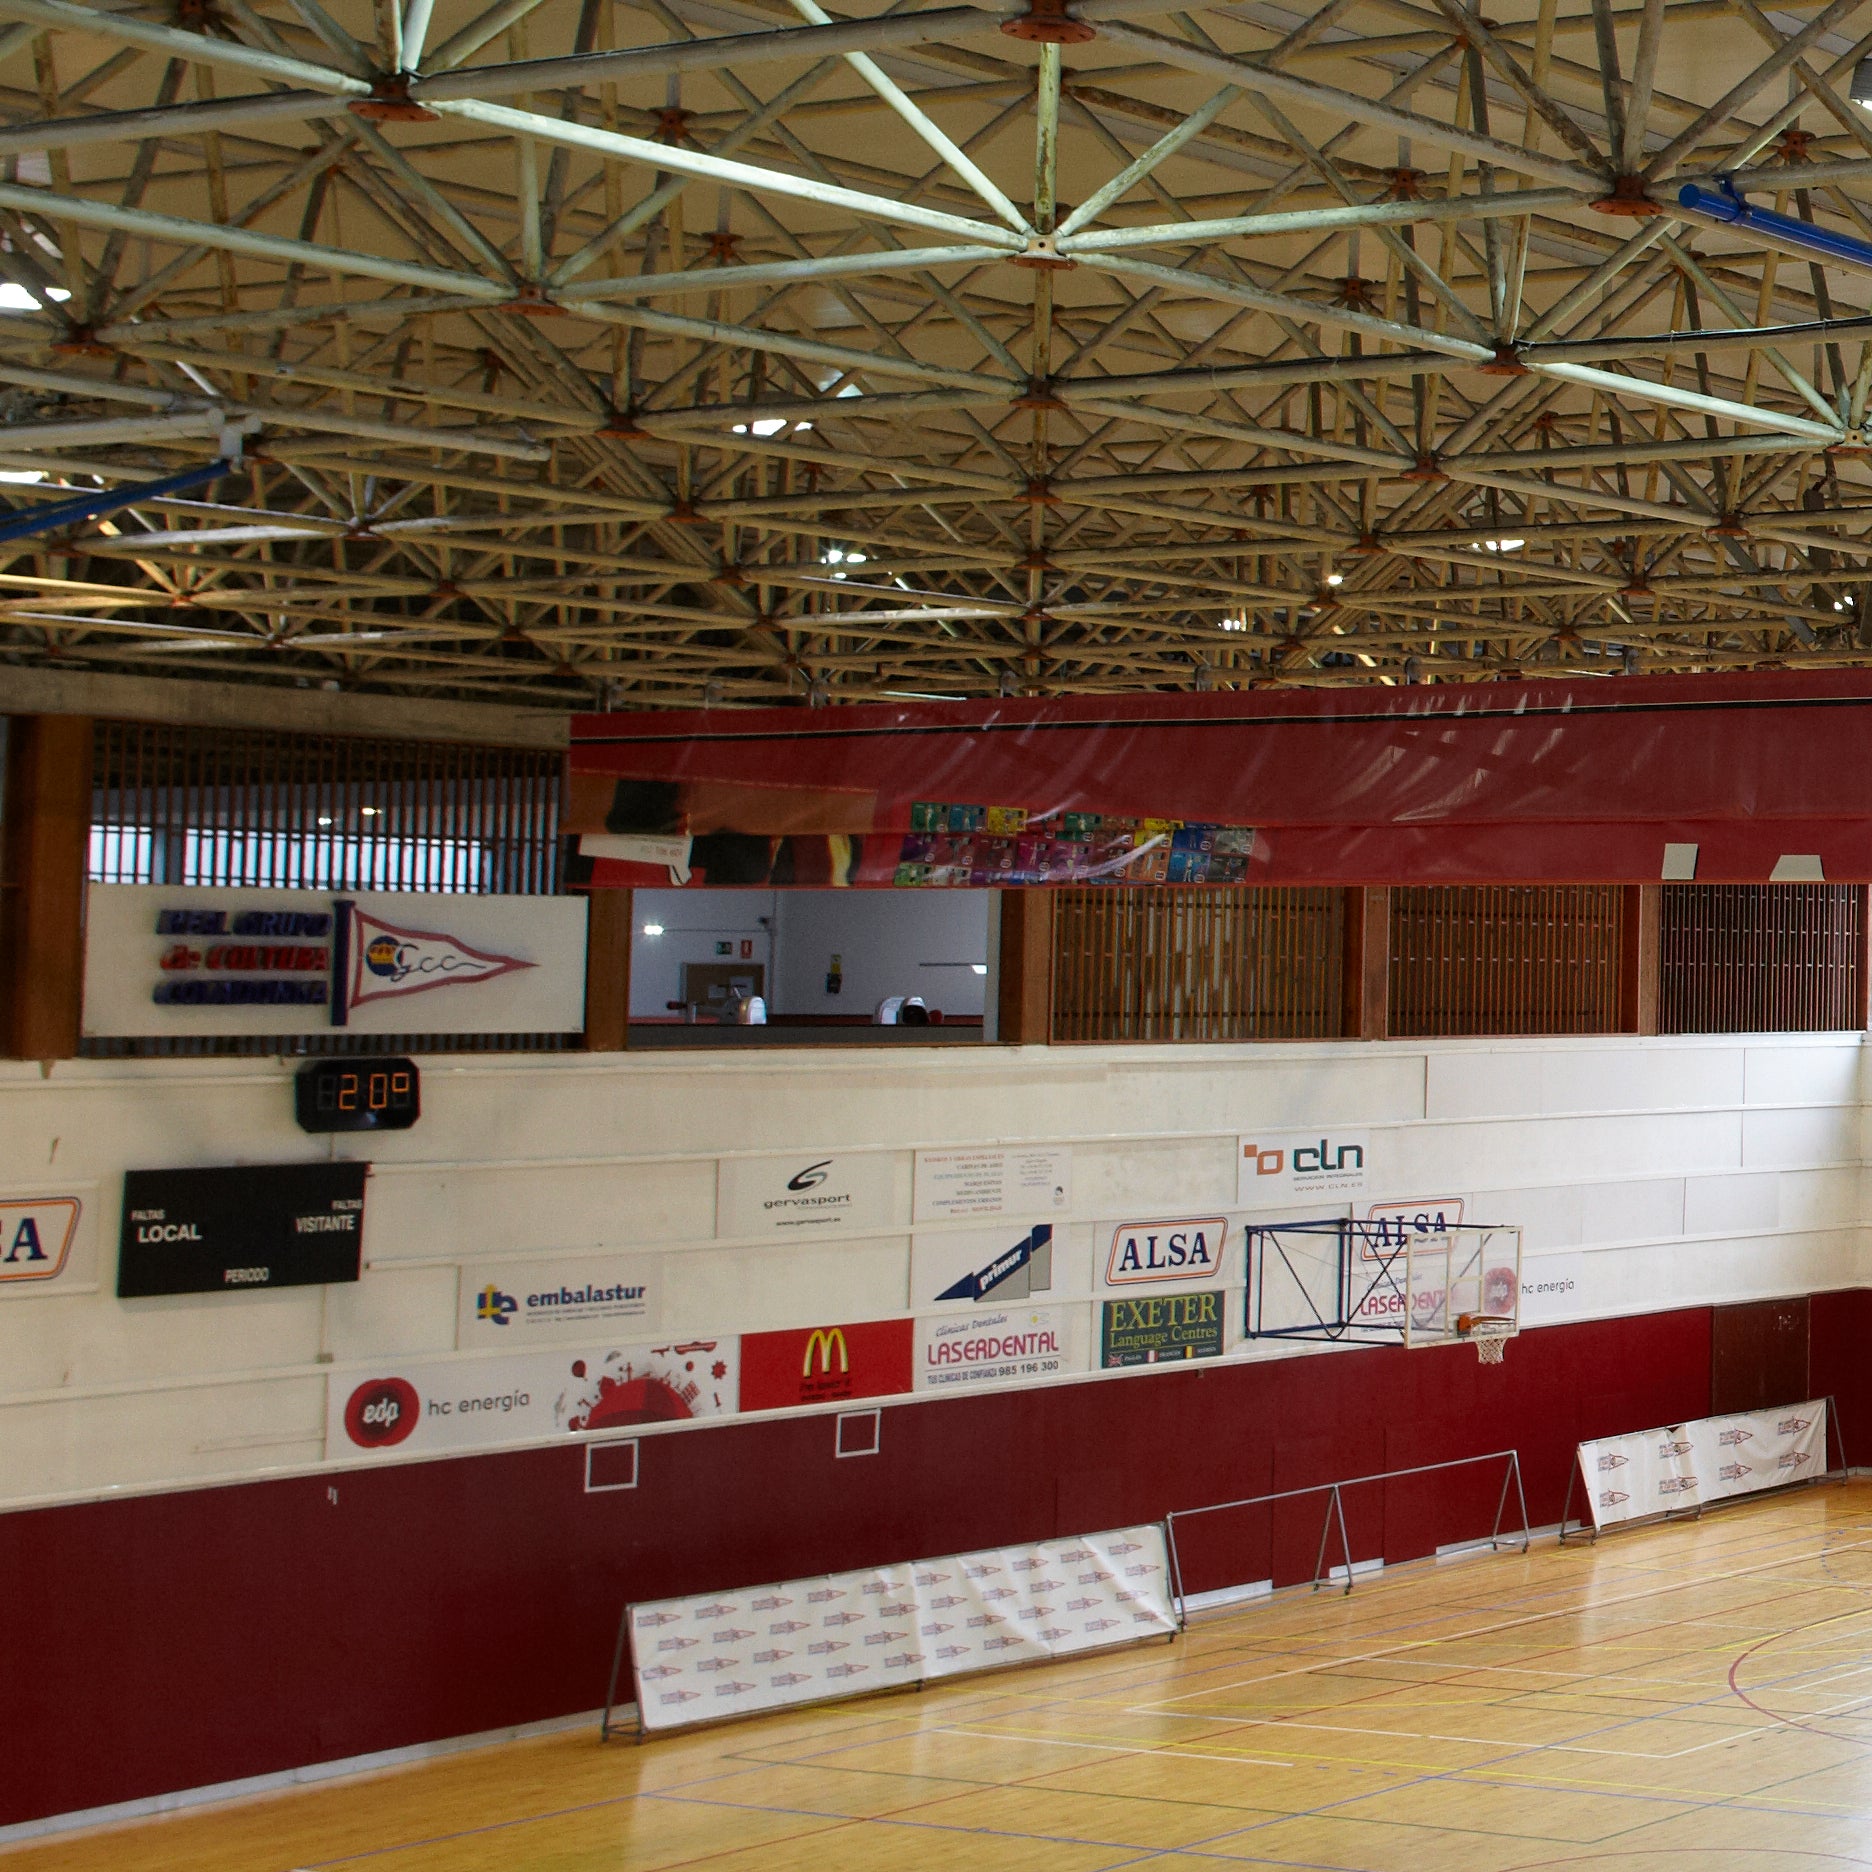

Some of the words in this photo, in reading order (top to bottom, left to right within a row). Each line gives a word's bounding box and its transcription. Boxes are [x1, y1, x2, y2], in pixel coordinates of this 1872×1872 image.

[763, 1193, 851, 1210] gervasport
[136, 1224, 203, 1243] LOCAL
[295, 1214, 355, 1233] VISITANTE
[1118, 1231, 1213, 1272] ALSA
[526, 1284, 647, 1307] embalastur
[1521, 1283, 1534, 1295] hc
[1537, 1278, 1575, 1294] energía
[1110, 1293, 1218, 1332] EXETER
[927, 1330, 1060, 1366] LASERDENTAL
[1110, 1331, 1168, 1349] Language
[1171, 1326, 1218, 1342] Centres
[998, 1365, 1018, 1377] 985
[1020, 1363, 1039, 1374] 196
[1040, 1360, 1060, 1372] 300
[363, 1396, 400, 1428] edp
[427, 1397, 452, 1416] hc
[457, 1389, 531, 1415] energía
